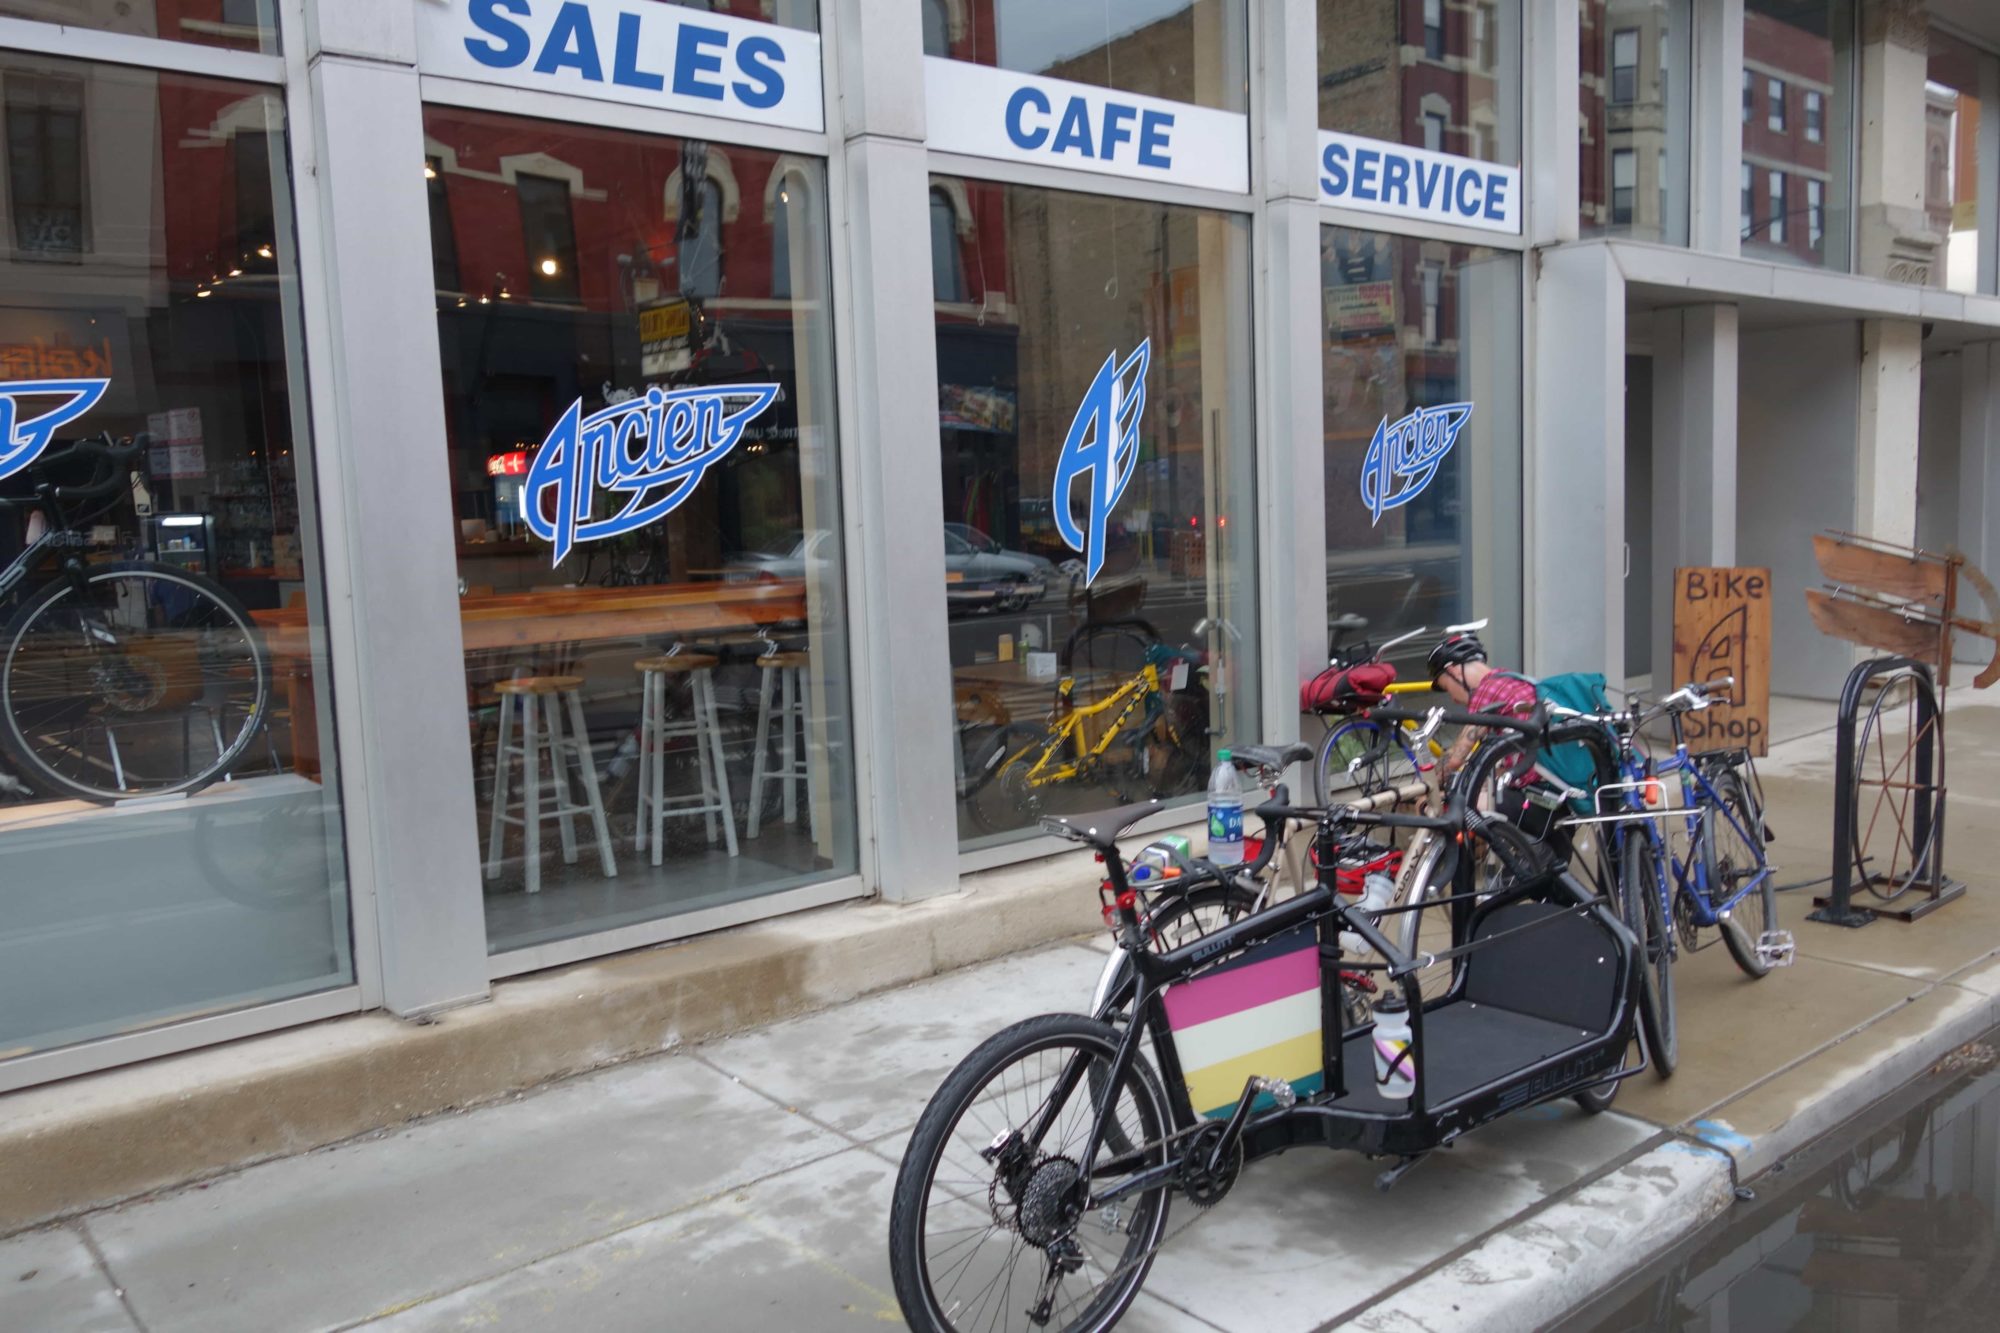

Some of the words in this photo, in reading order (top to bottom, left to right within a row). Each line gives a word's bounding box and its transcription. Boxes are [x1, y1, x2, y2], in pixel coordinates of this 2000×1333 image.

[464, 0, 785, 110] SALES
[1005, 86, 1175, 169] CAFE
[1320, 143, 1509, 222] SERVICE
[520, 382, 780, 567] Ancien
[1360, 401, 1474, 528] Ancien
[1686, 572, 1764, 600] Bike
[1684, 708, 1762, 746] Shop
